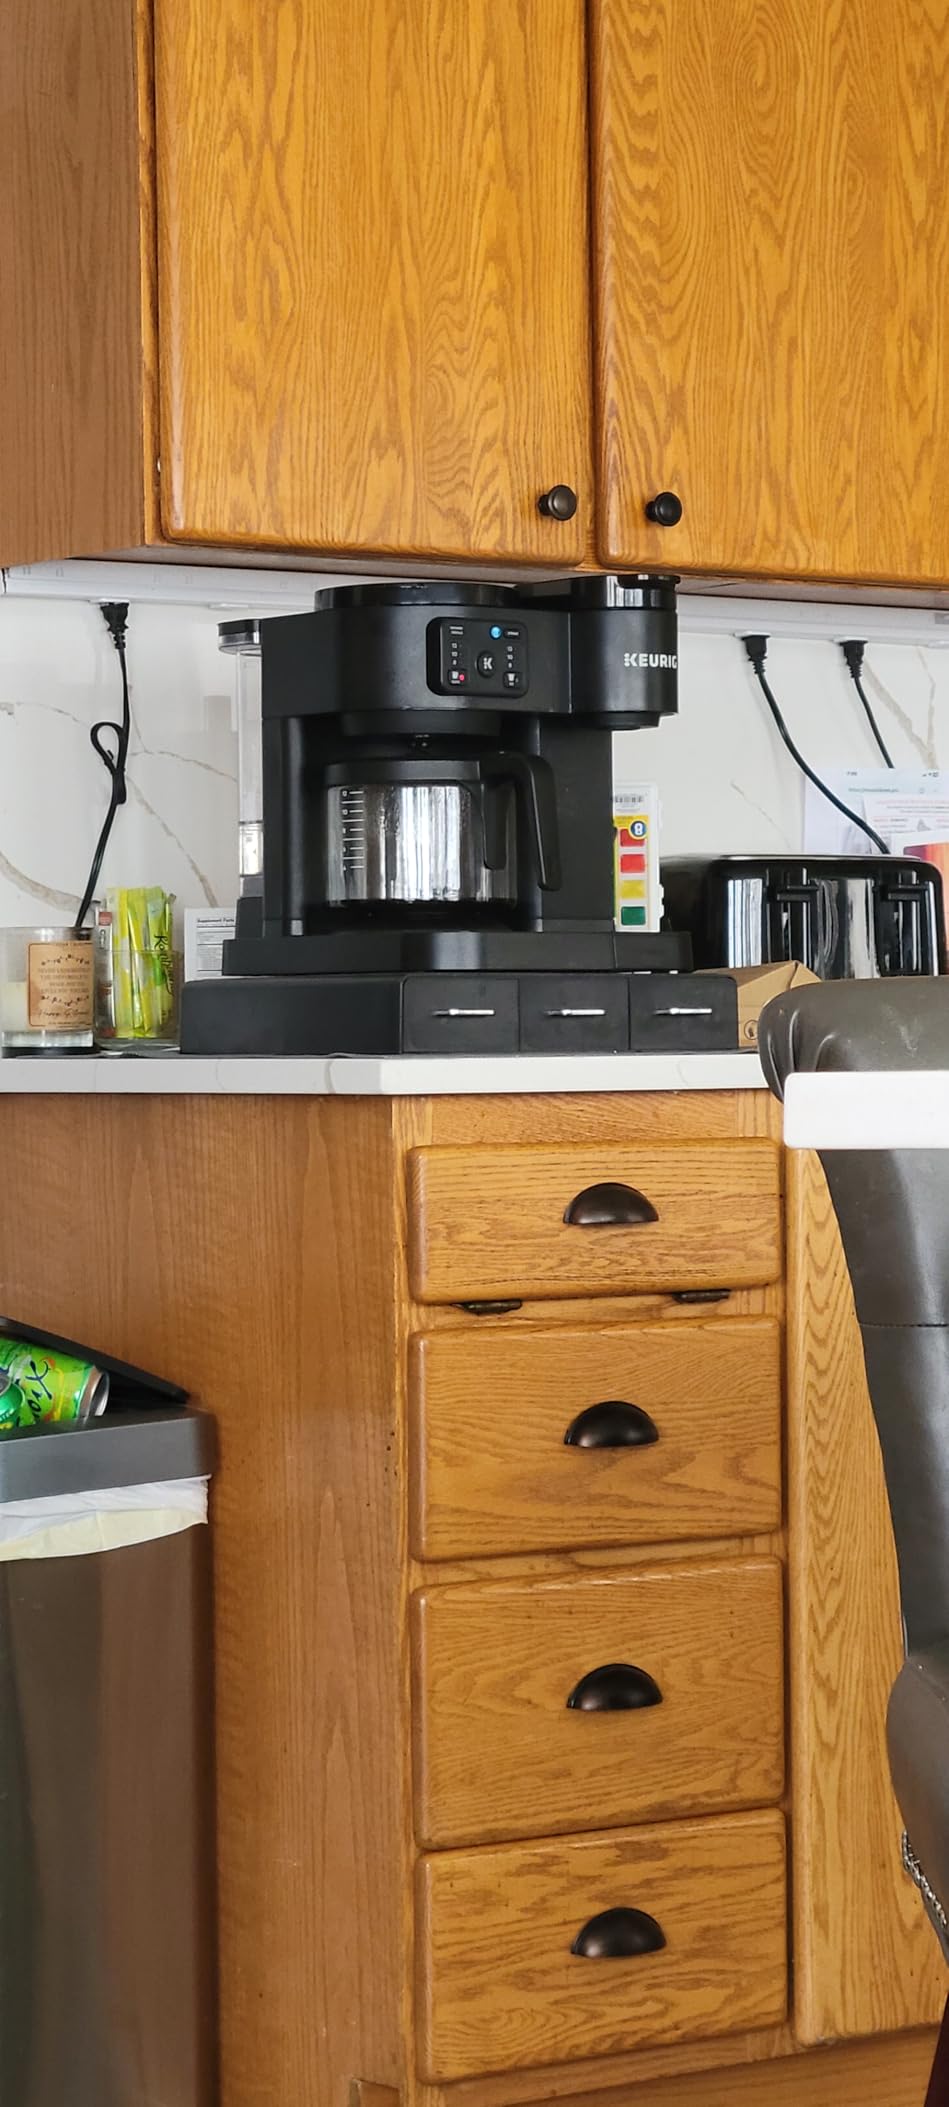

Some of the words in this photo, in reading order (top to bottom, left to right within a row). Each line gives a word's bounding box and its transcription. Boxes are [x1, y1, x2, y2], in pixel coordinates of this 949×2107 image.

[483, 657, 492, 670] K
[623, 652, 678, 669] KEURIG
[634, 822, 644, 836] 8
